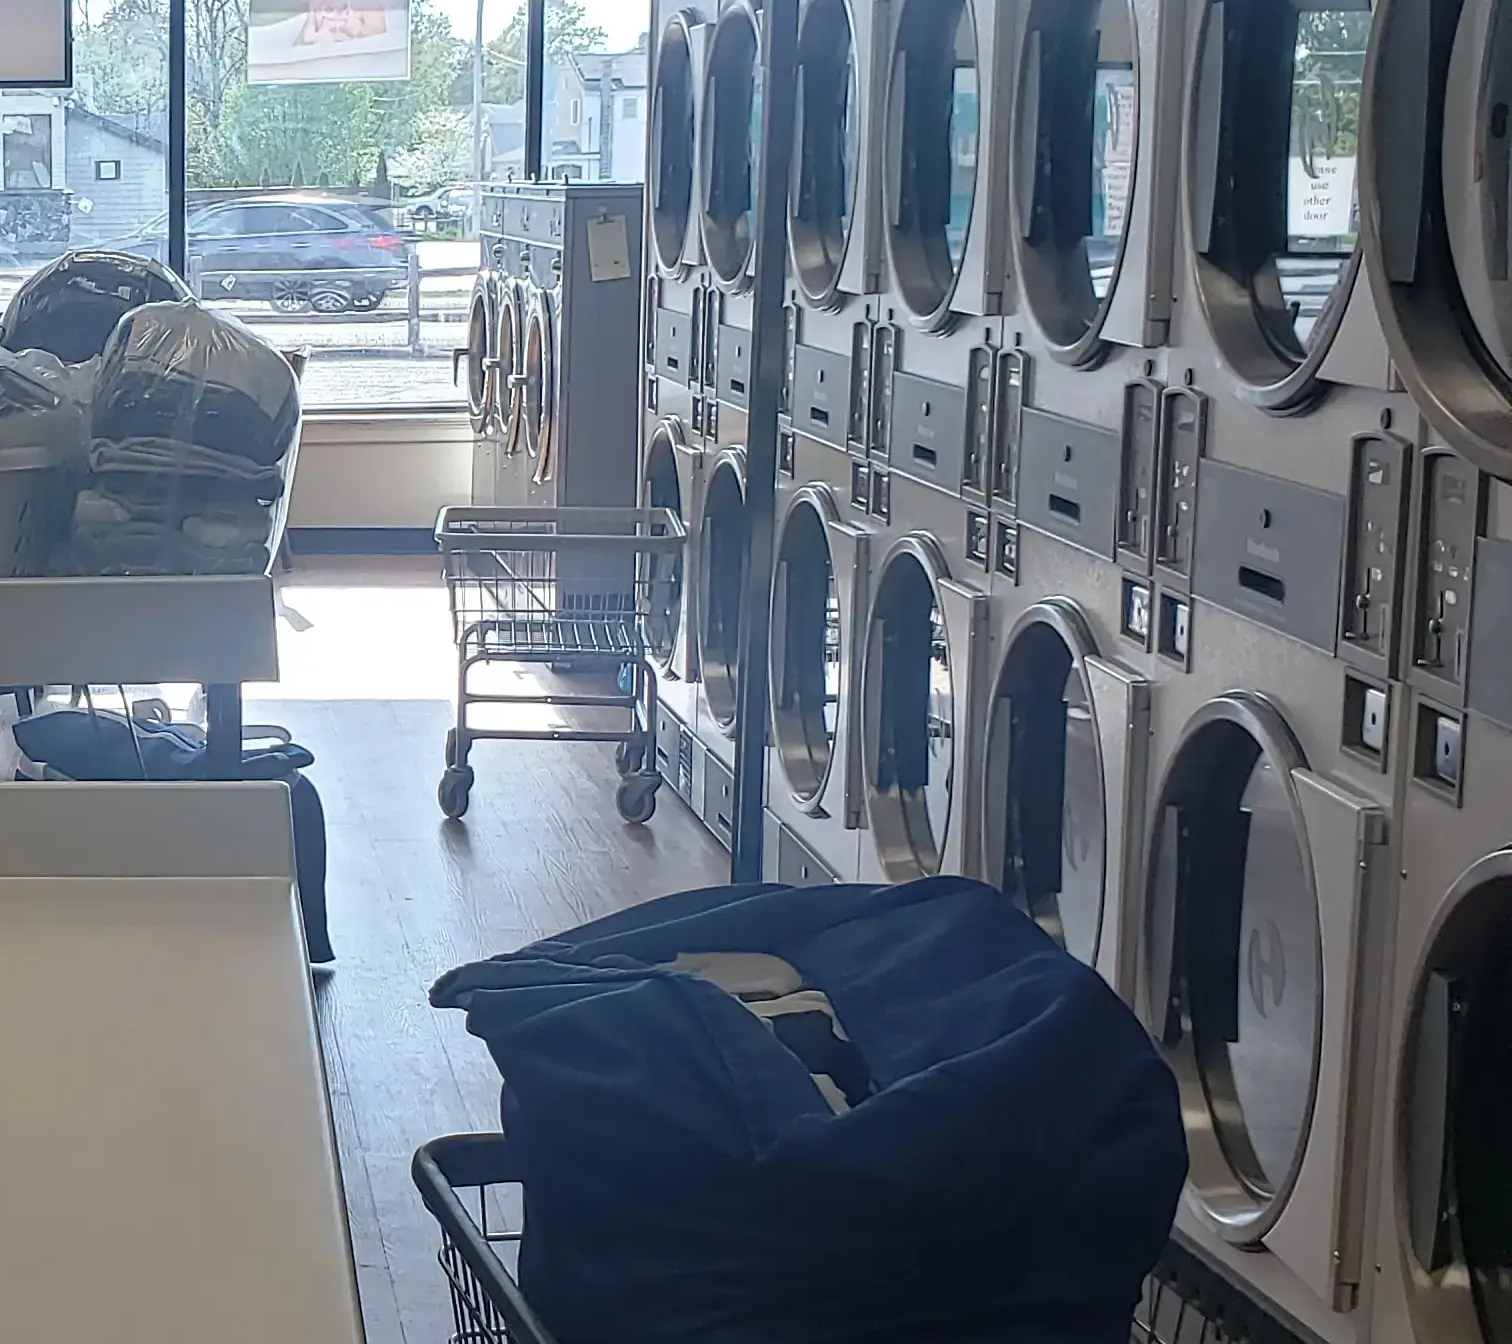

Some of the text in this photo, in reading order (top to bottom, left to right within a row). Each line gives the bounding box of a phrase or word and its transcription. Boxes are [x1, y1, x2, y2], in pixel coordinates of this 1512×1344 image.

[1310, 182, 1330, 190] use
[1303, 195, 1331, 206] other
[1303, 210, 1329, 221] door
